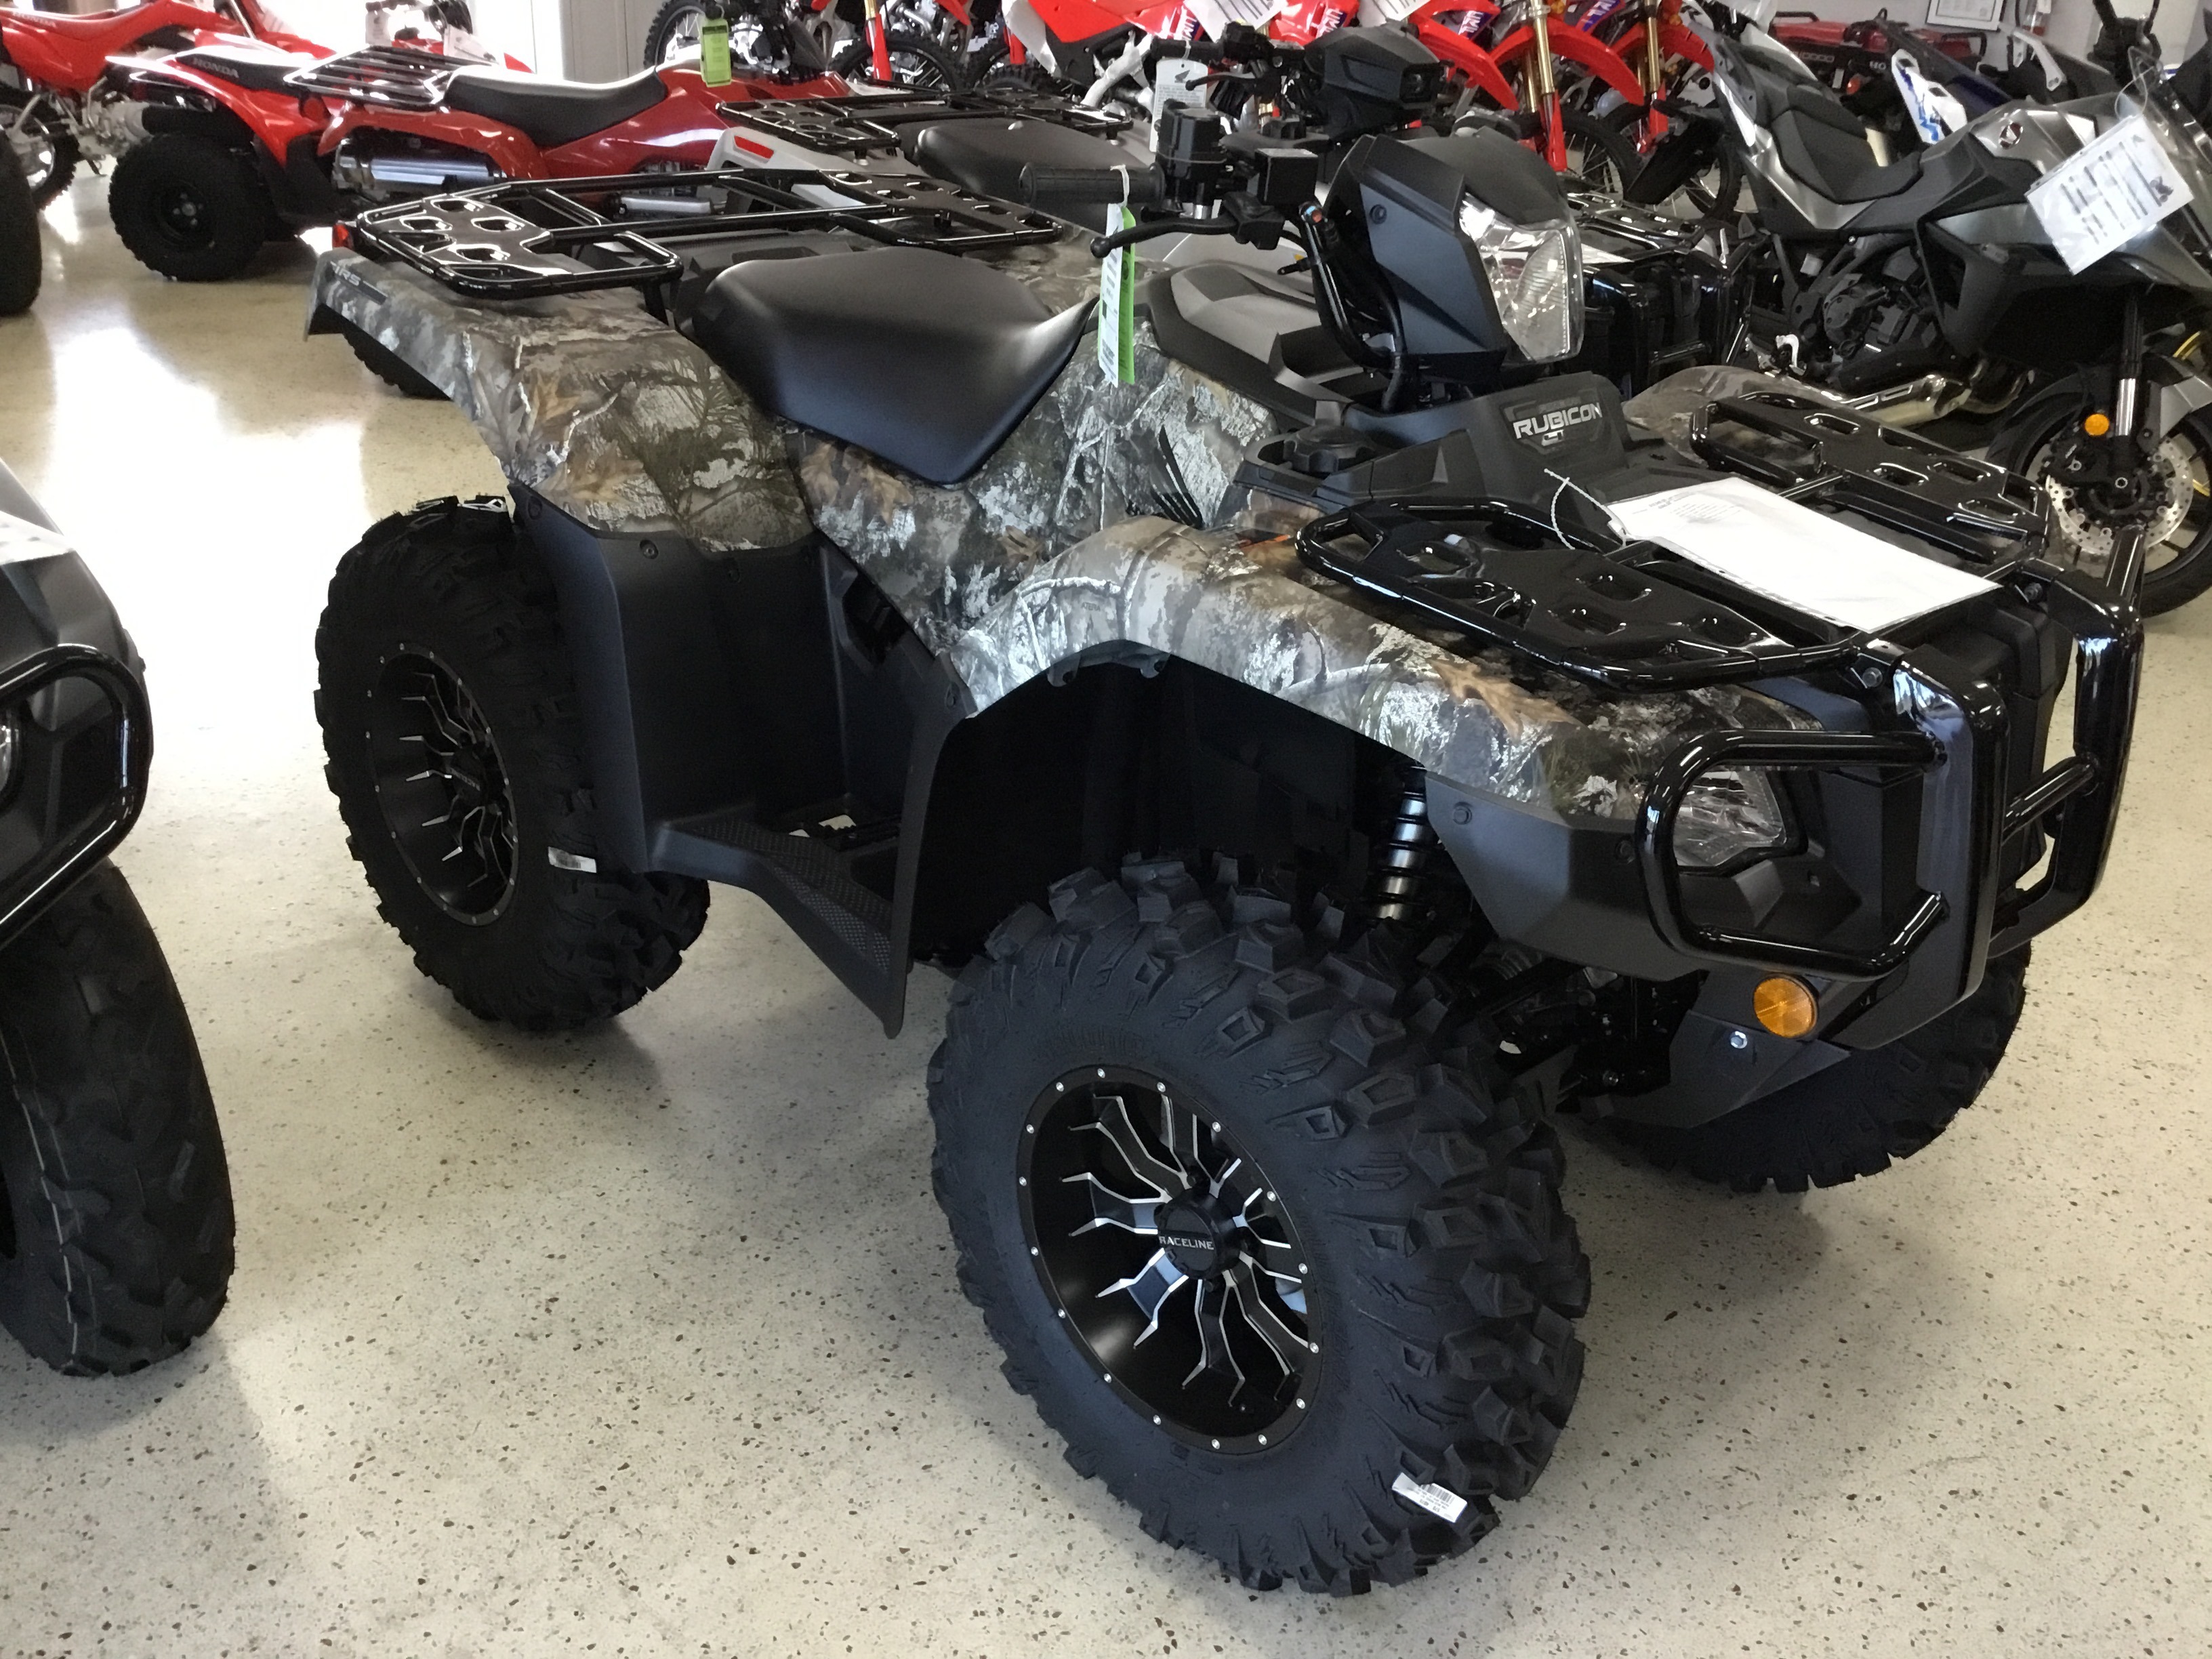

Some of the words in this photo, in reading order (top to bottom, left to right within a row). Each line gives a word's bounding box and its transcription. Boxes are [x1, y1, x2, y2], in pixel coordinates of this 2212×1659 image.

[192, 58, 240, 79] HONDA
[334, 265, 362, 287] IRS
[1513, 402, 1603, 439] RUBICON
[1158, 1235, 1214, 1250] RACELINE
